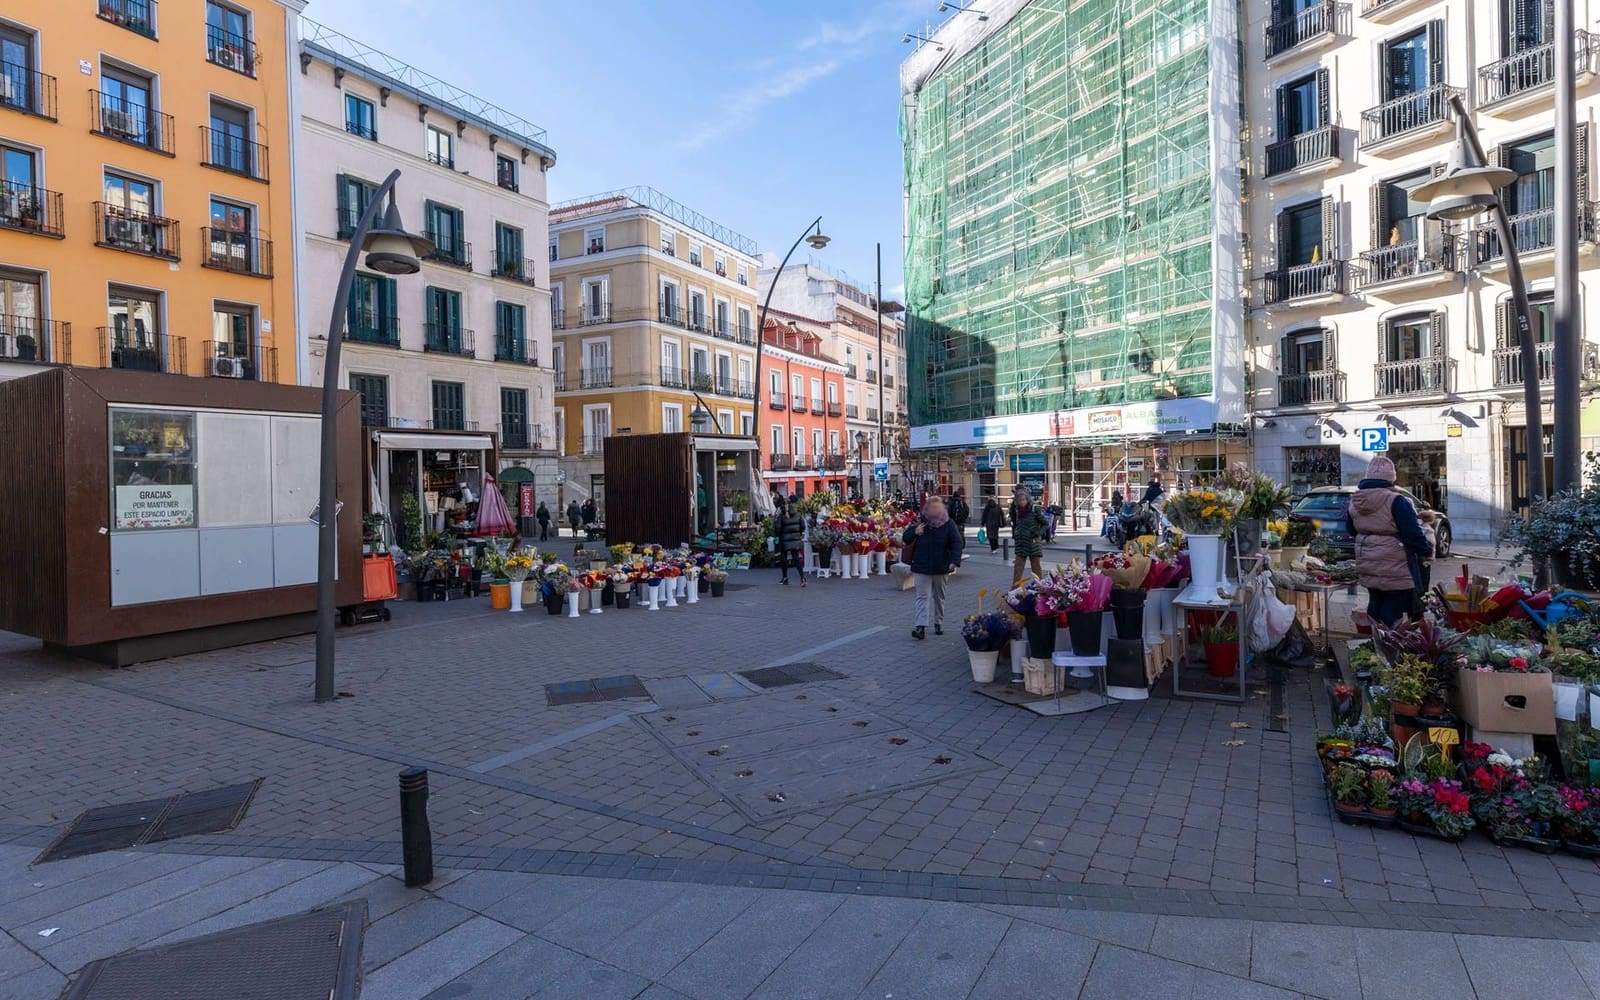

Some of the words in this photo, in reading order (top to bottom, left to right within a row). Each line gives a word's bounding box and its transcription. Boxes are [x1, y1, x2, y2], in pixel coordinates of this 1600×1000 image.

[1093, 415, 1117, 423] MOSAICO
[1365, 430, 1380, 449] P
[139, 490, 172, 499] GRACIAS
[124, 511, 139, 519] ESTE
[141, 510, 166, 518] ESPACIO
